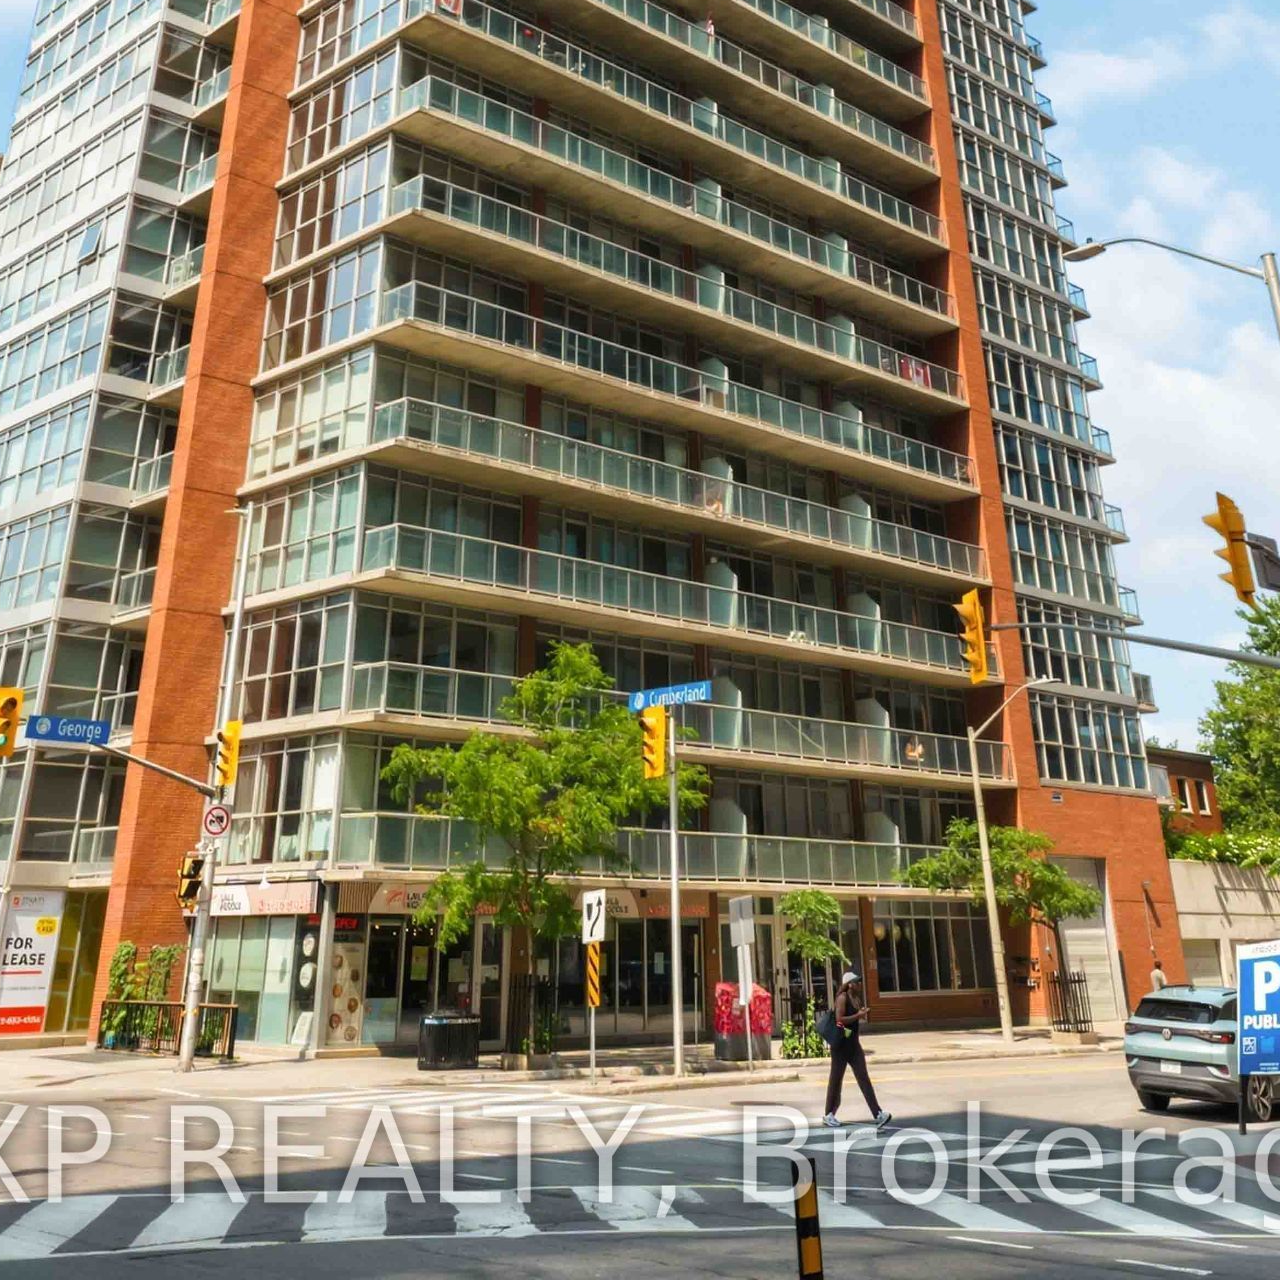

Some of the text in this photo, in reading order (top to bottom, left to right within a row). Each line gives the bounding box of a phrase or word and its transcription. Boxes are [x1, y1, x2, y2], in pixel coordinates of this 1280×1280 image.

[649, 684, 706, 707] Cumberland
[58, 718, 102, 742] George
[5, 937, 33, 950] FOR
[2, 953, 46, 966] LEASE
